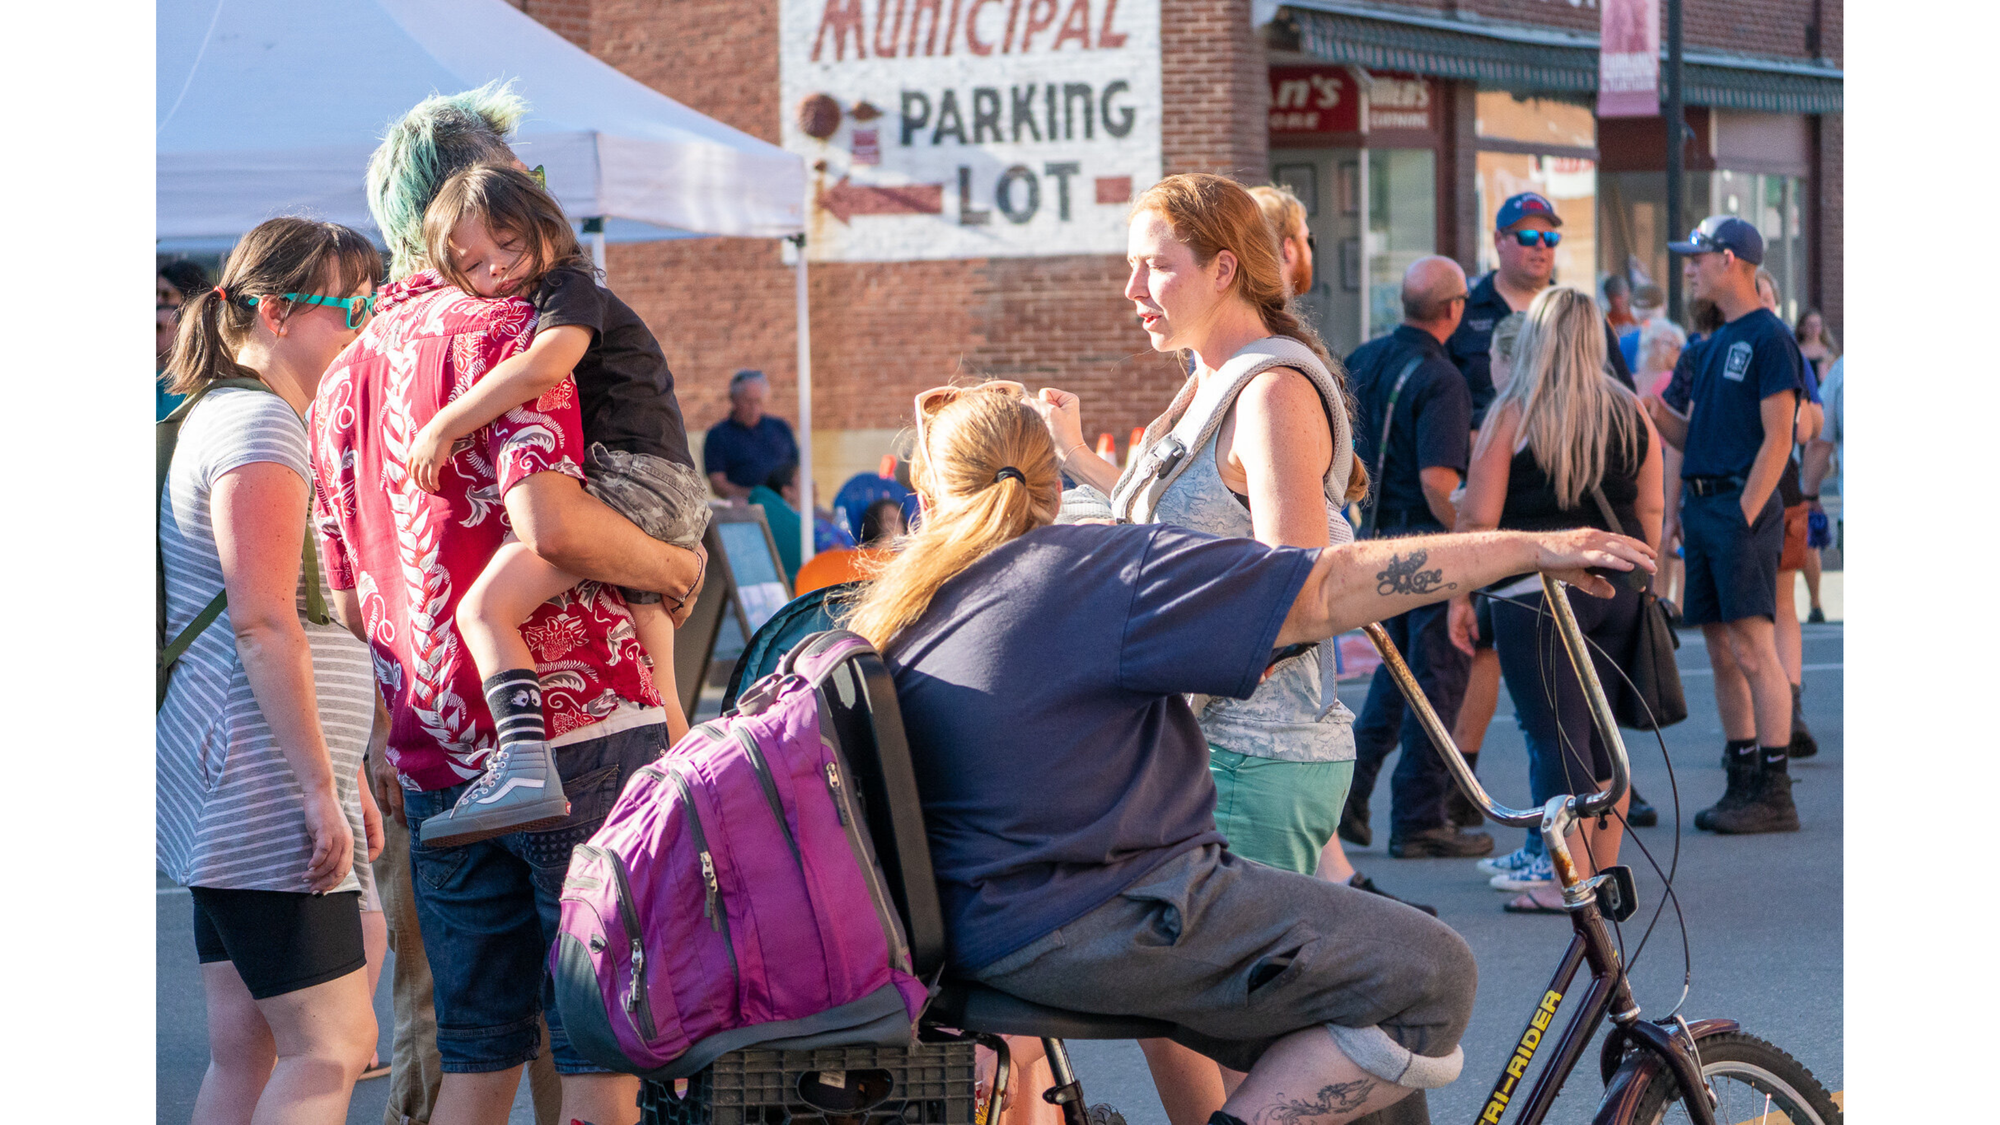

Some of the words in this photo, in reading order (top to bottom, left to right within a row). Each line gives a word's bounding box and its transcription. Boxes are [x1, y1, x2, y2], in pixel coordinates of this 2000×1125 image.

[901, 80, 1135, 146] PARKING
[959, 162, 1080, 225] LOT
[1478, 989, 1562, 1125] RI-RIDER
